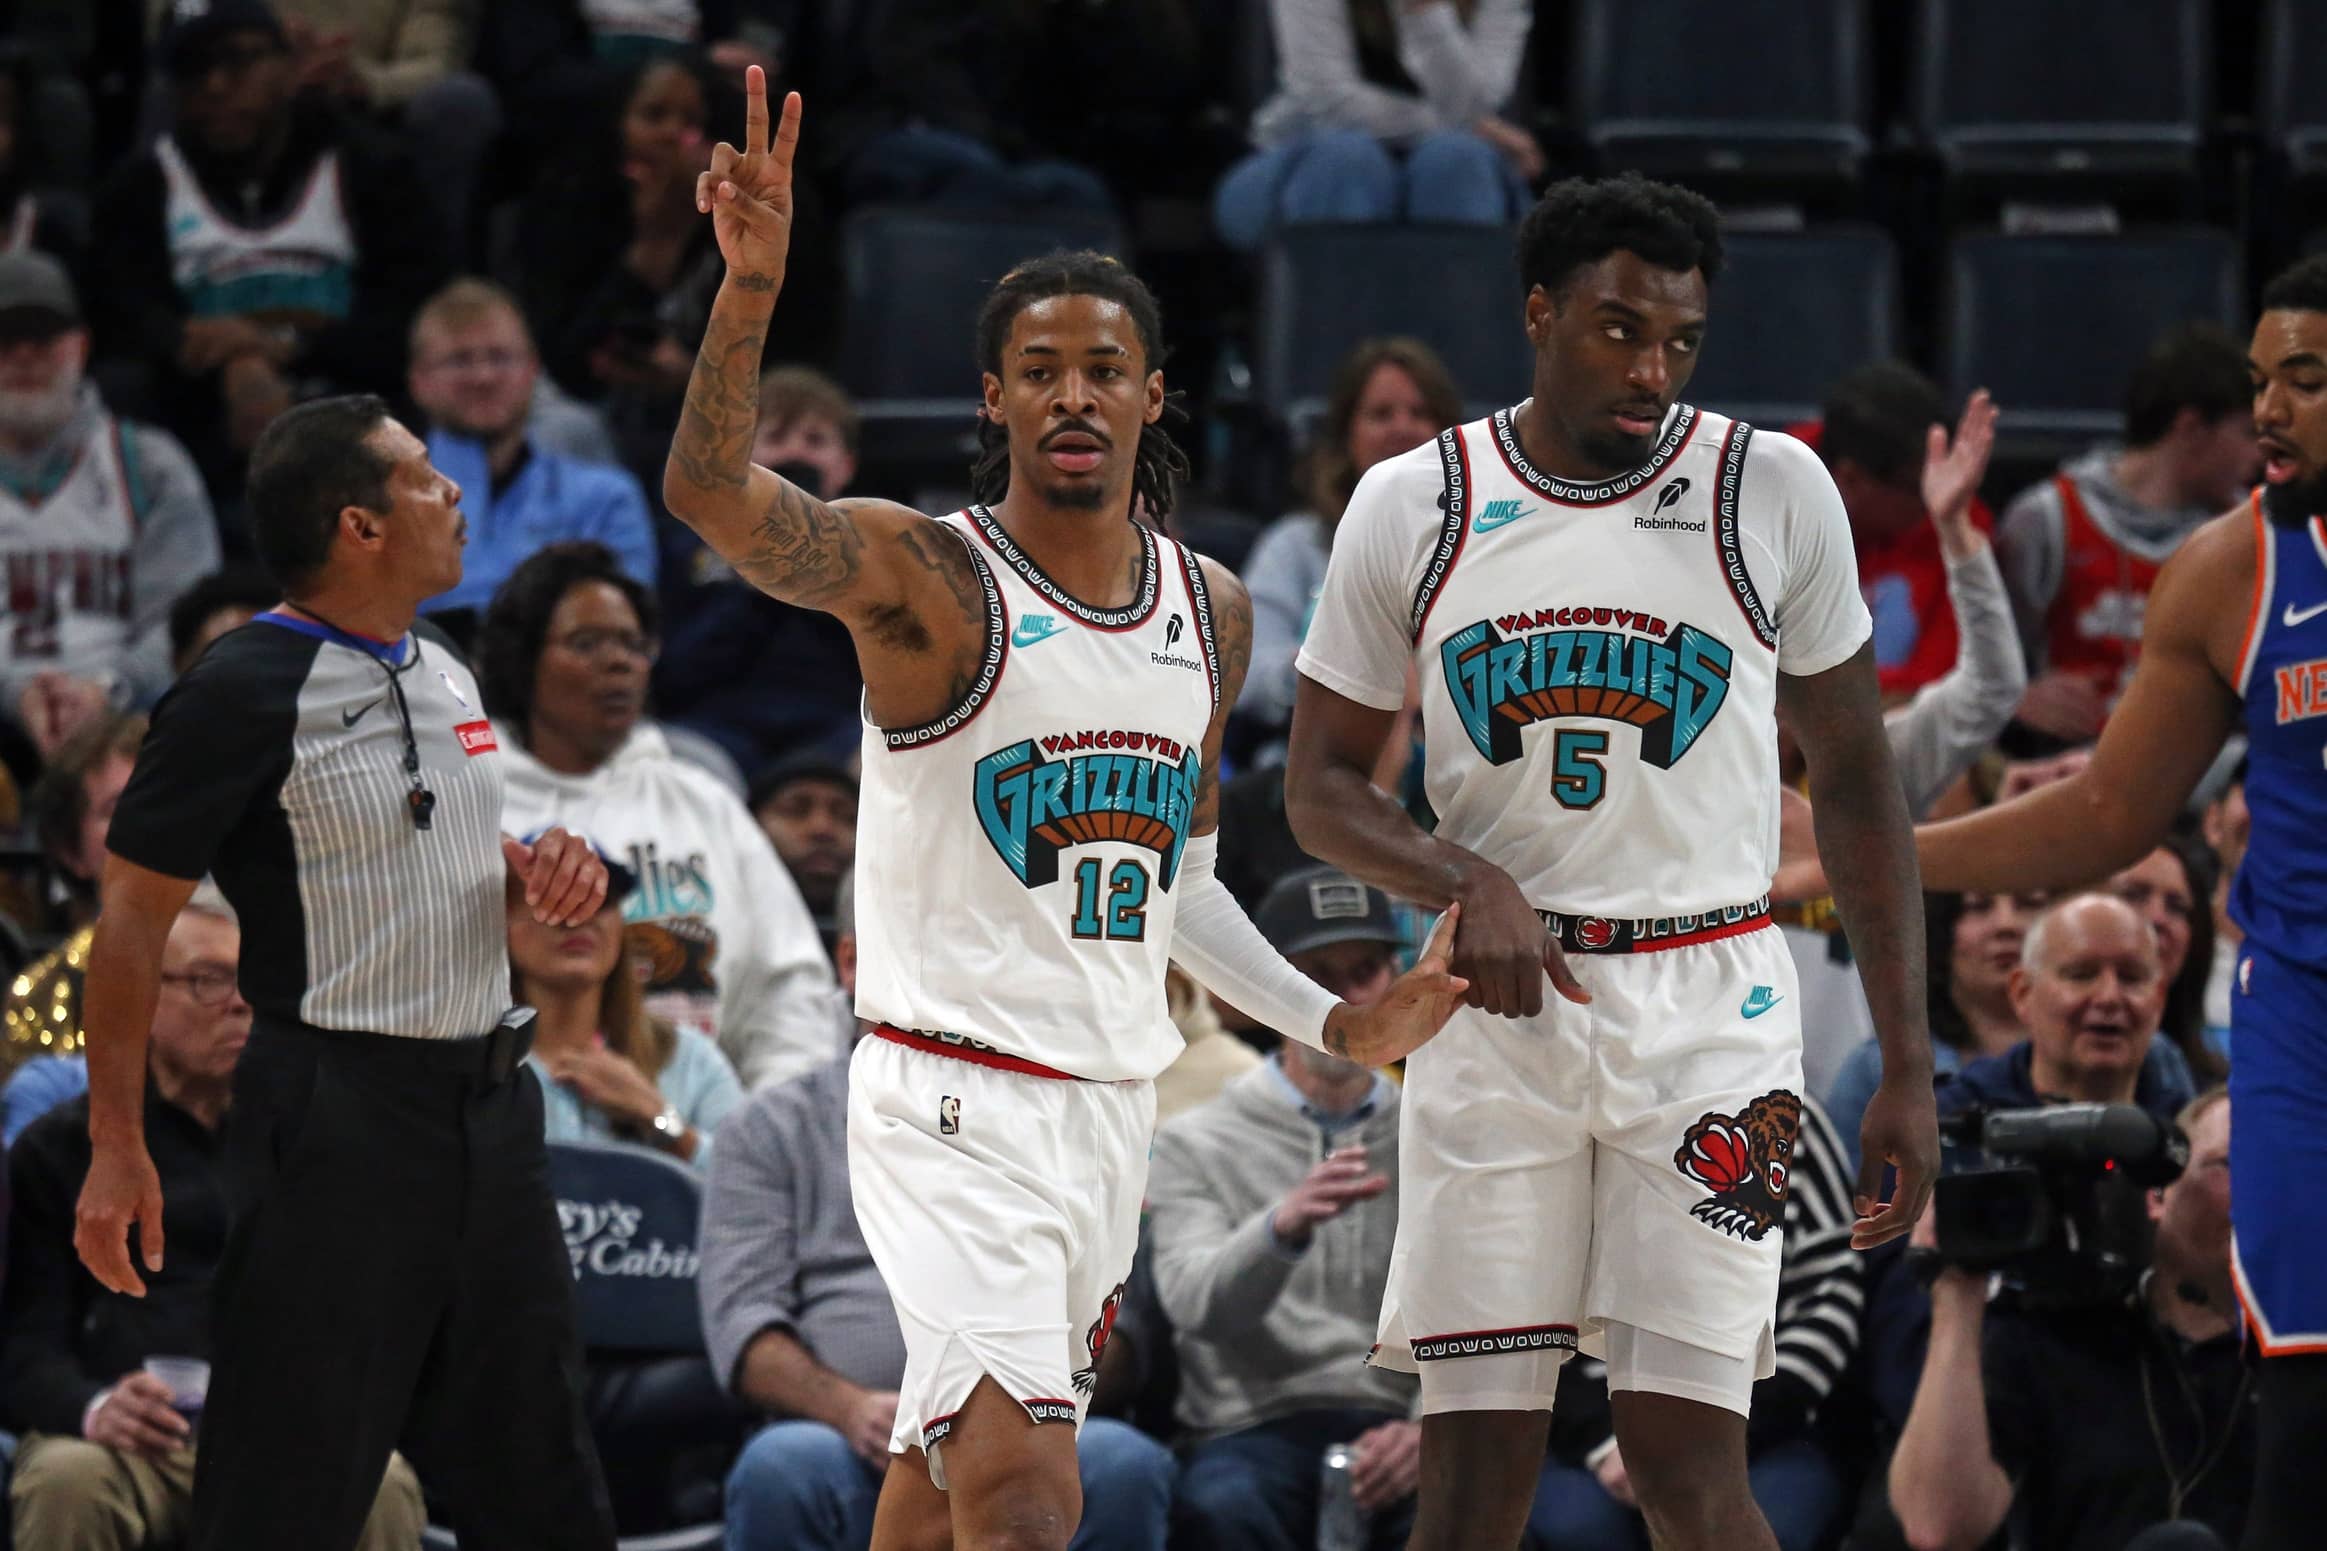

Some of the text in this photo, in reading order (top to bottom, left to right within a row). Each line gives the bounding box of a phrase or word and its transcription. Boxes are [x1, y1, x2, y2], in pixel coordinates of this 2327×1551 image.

[1482, 499, 1523, 519] NIKE
[1634, 516, 1706, 532] Robinhood
[1019, 614, 1055, 633] NIKE
[1496, 606, 1668, 637] VANCOUVER
[1151, 651, 1202, 672] Robinhood
[1440, 618, 1734, 771] GRIZZLIES
[2274, 658, 2327, 726] NE
[1040, 730, 1183, 762] VANCOUVER
[1550, 727, 1610, 811] 5
[972, 737, 1202, 894] GRIZZLIES
[1071, 856, 1151, 942] 12
